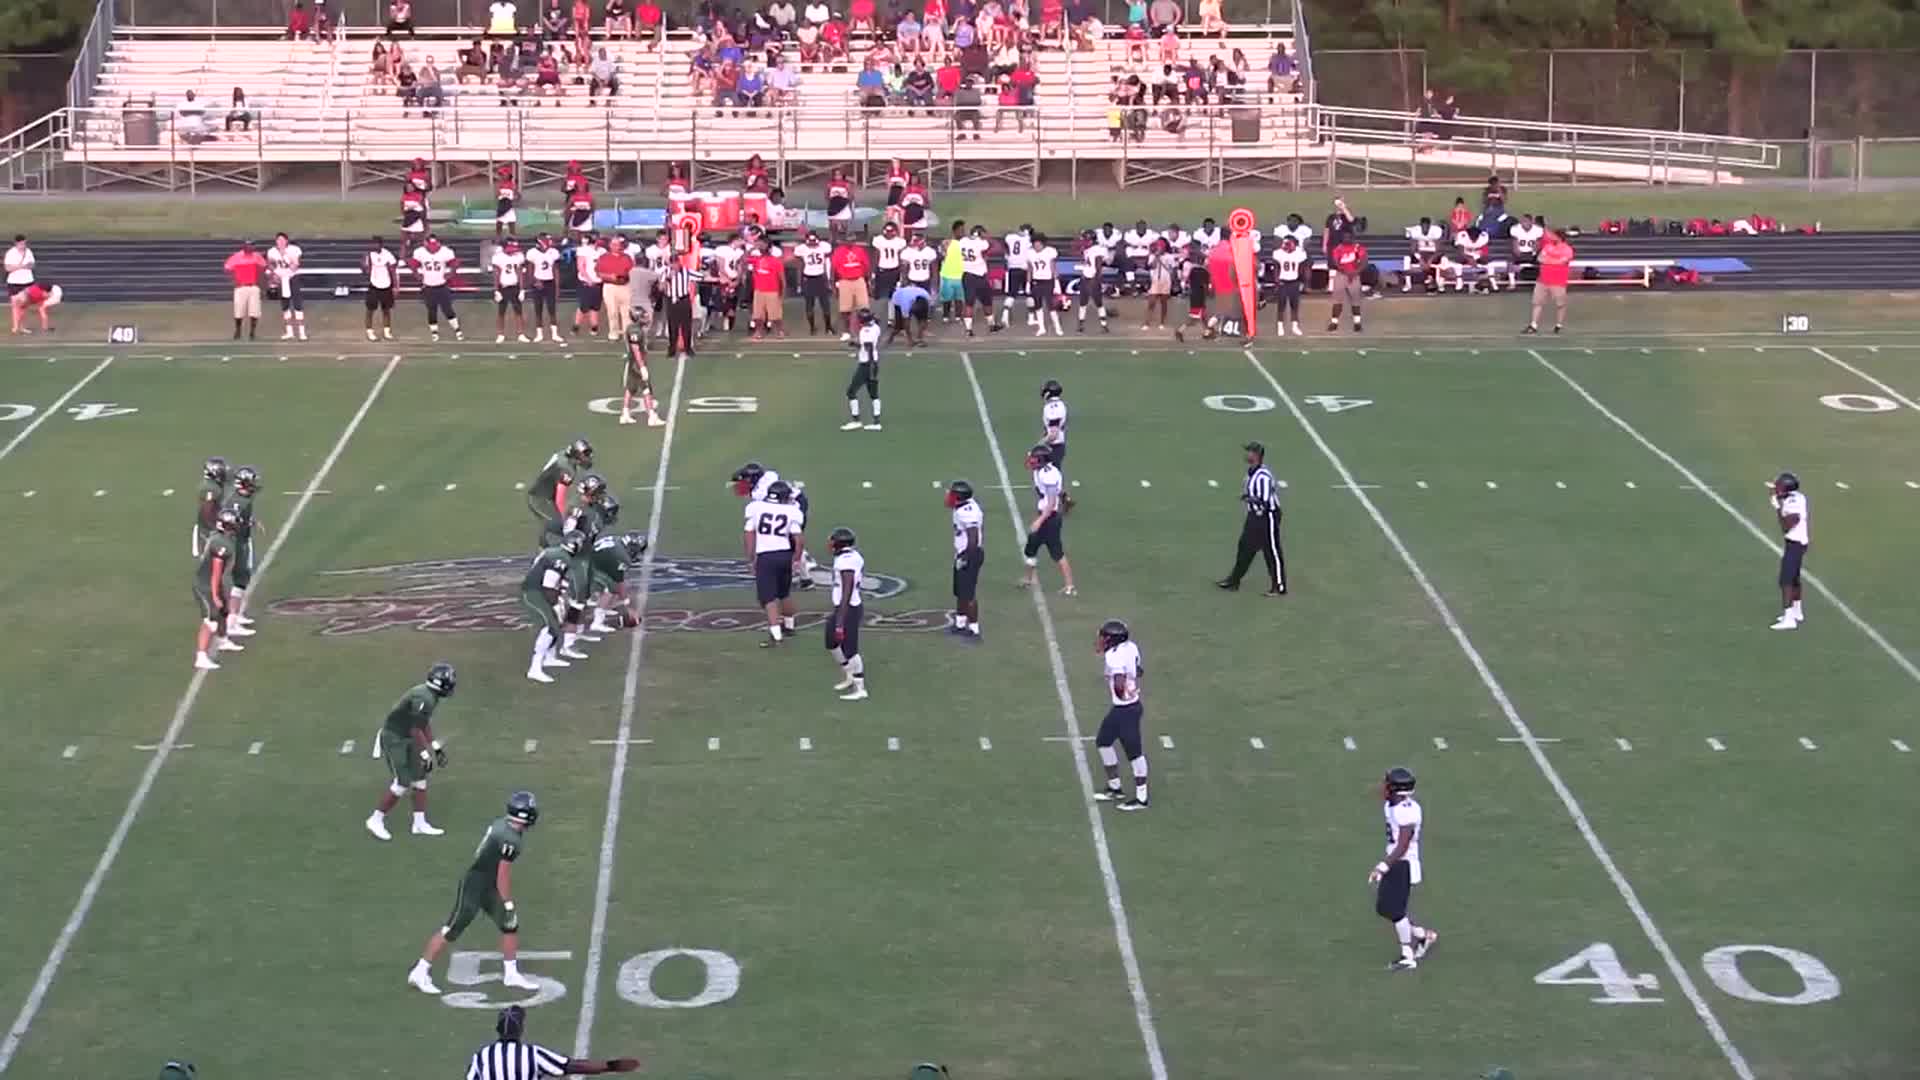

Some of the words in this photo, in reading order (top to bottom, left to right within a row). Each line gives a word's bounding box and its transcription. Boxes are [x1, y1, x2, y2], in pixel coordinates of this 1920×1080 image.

[113, 327, 134, 341] 40
[1788, 316, 1809, 331] 30
[758, 512, 788, 537] 62
[441, 948, 741, 1009] 50
[1533, 943, 1842, 1005] 40
